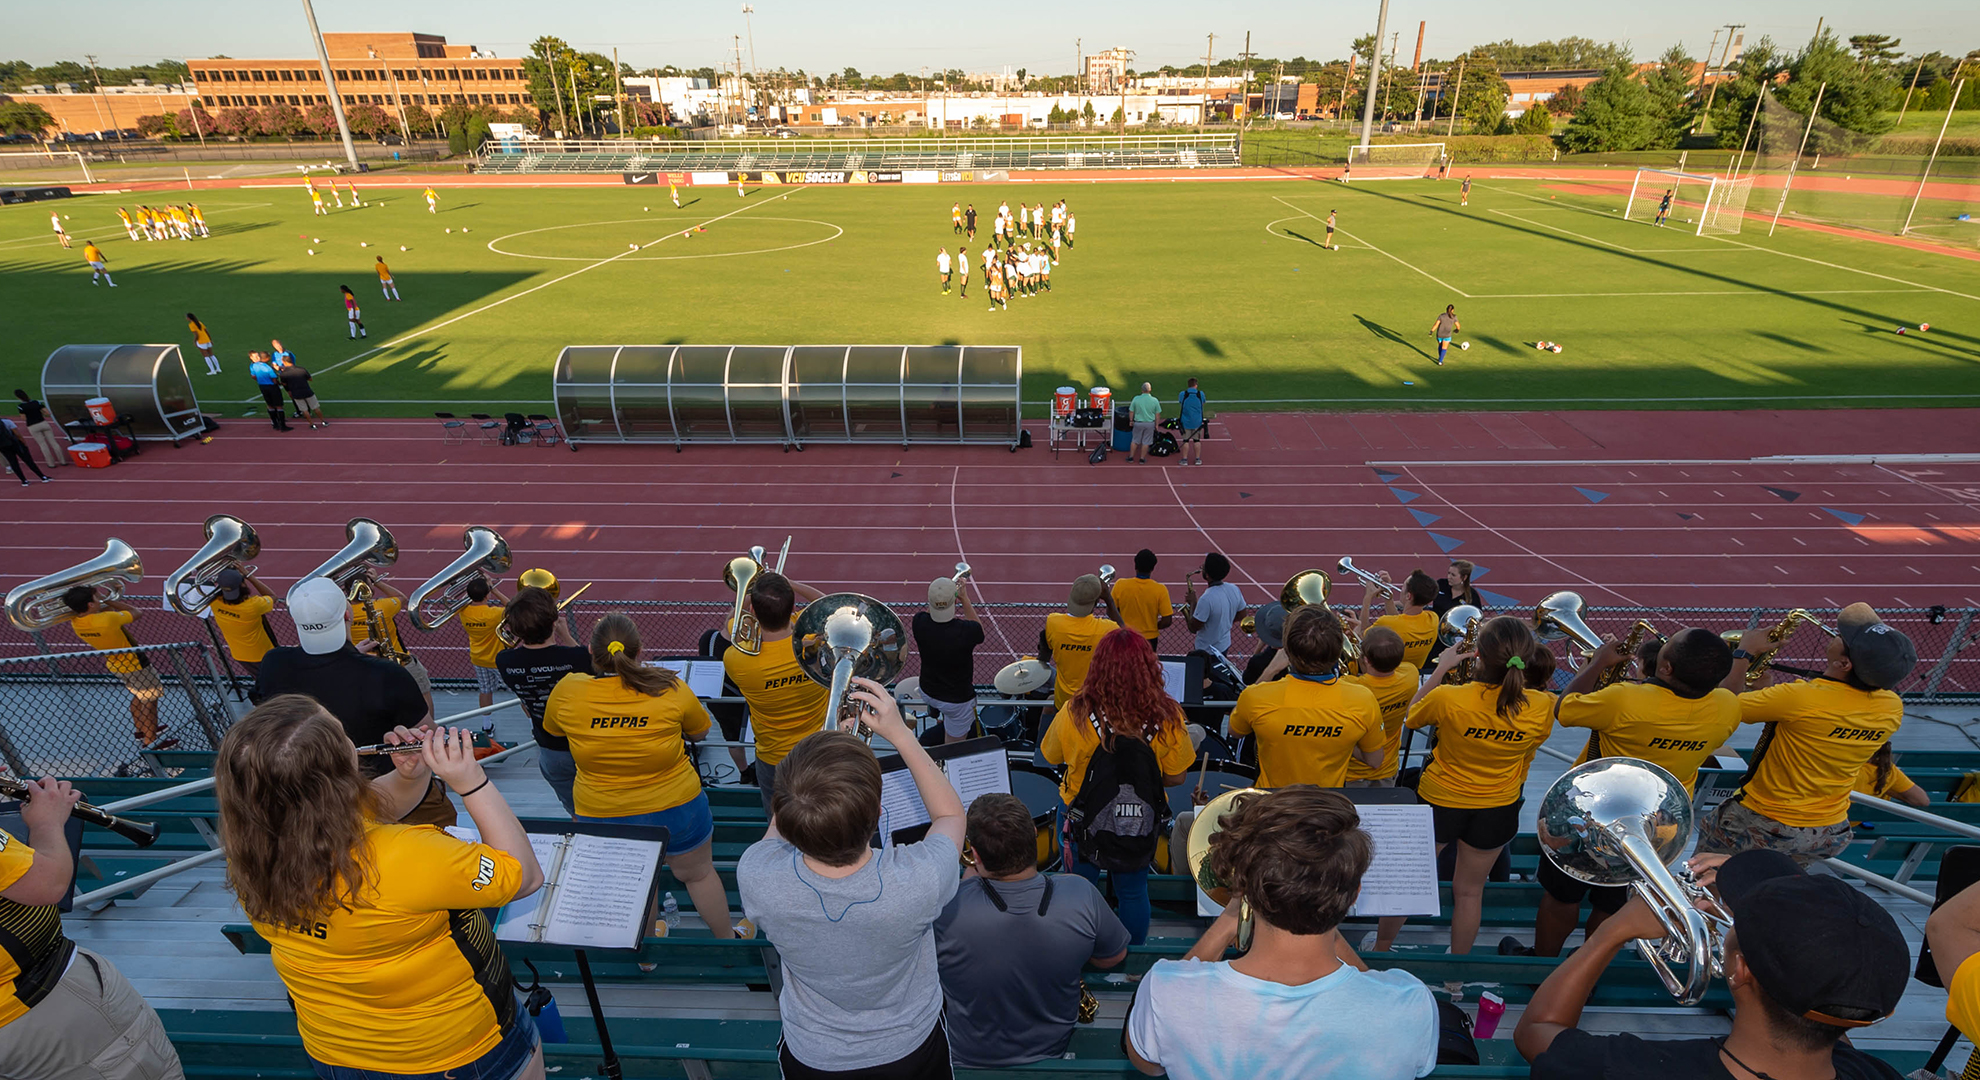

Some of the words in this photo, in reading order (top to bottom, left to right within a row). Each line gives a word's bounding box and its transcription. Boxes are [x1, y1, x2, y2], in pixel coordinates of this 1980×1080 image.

[218, 608, 240, 619] PEPPAS
[1060, 643, 1092, 652] PEPPAS
[765, 674, 809, 689] PEPPAS
[591, 716, 649, 729] PEPPAS
[1283, 724, 1343, 737] PEPPAS
[1463, 727, 1526, 742] PEPPAS
[1828, 727, 1886, 742] PEPPAS
[1648, 737, 1708, 751] PEPPAS
[1115, 804, 1143, 817] PINK
[477, 854, 495, 886] VCU
